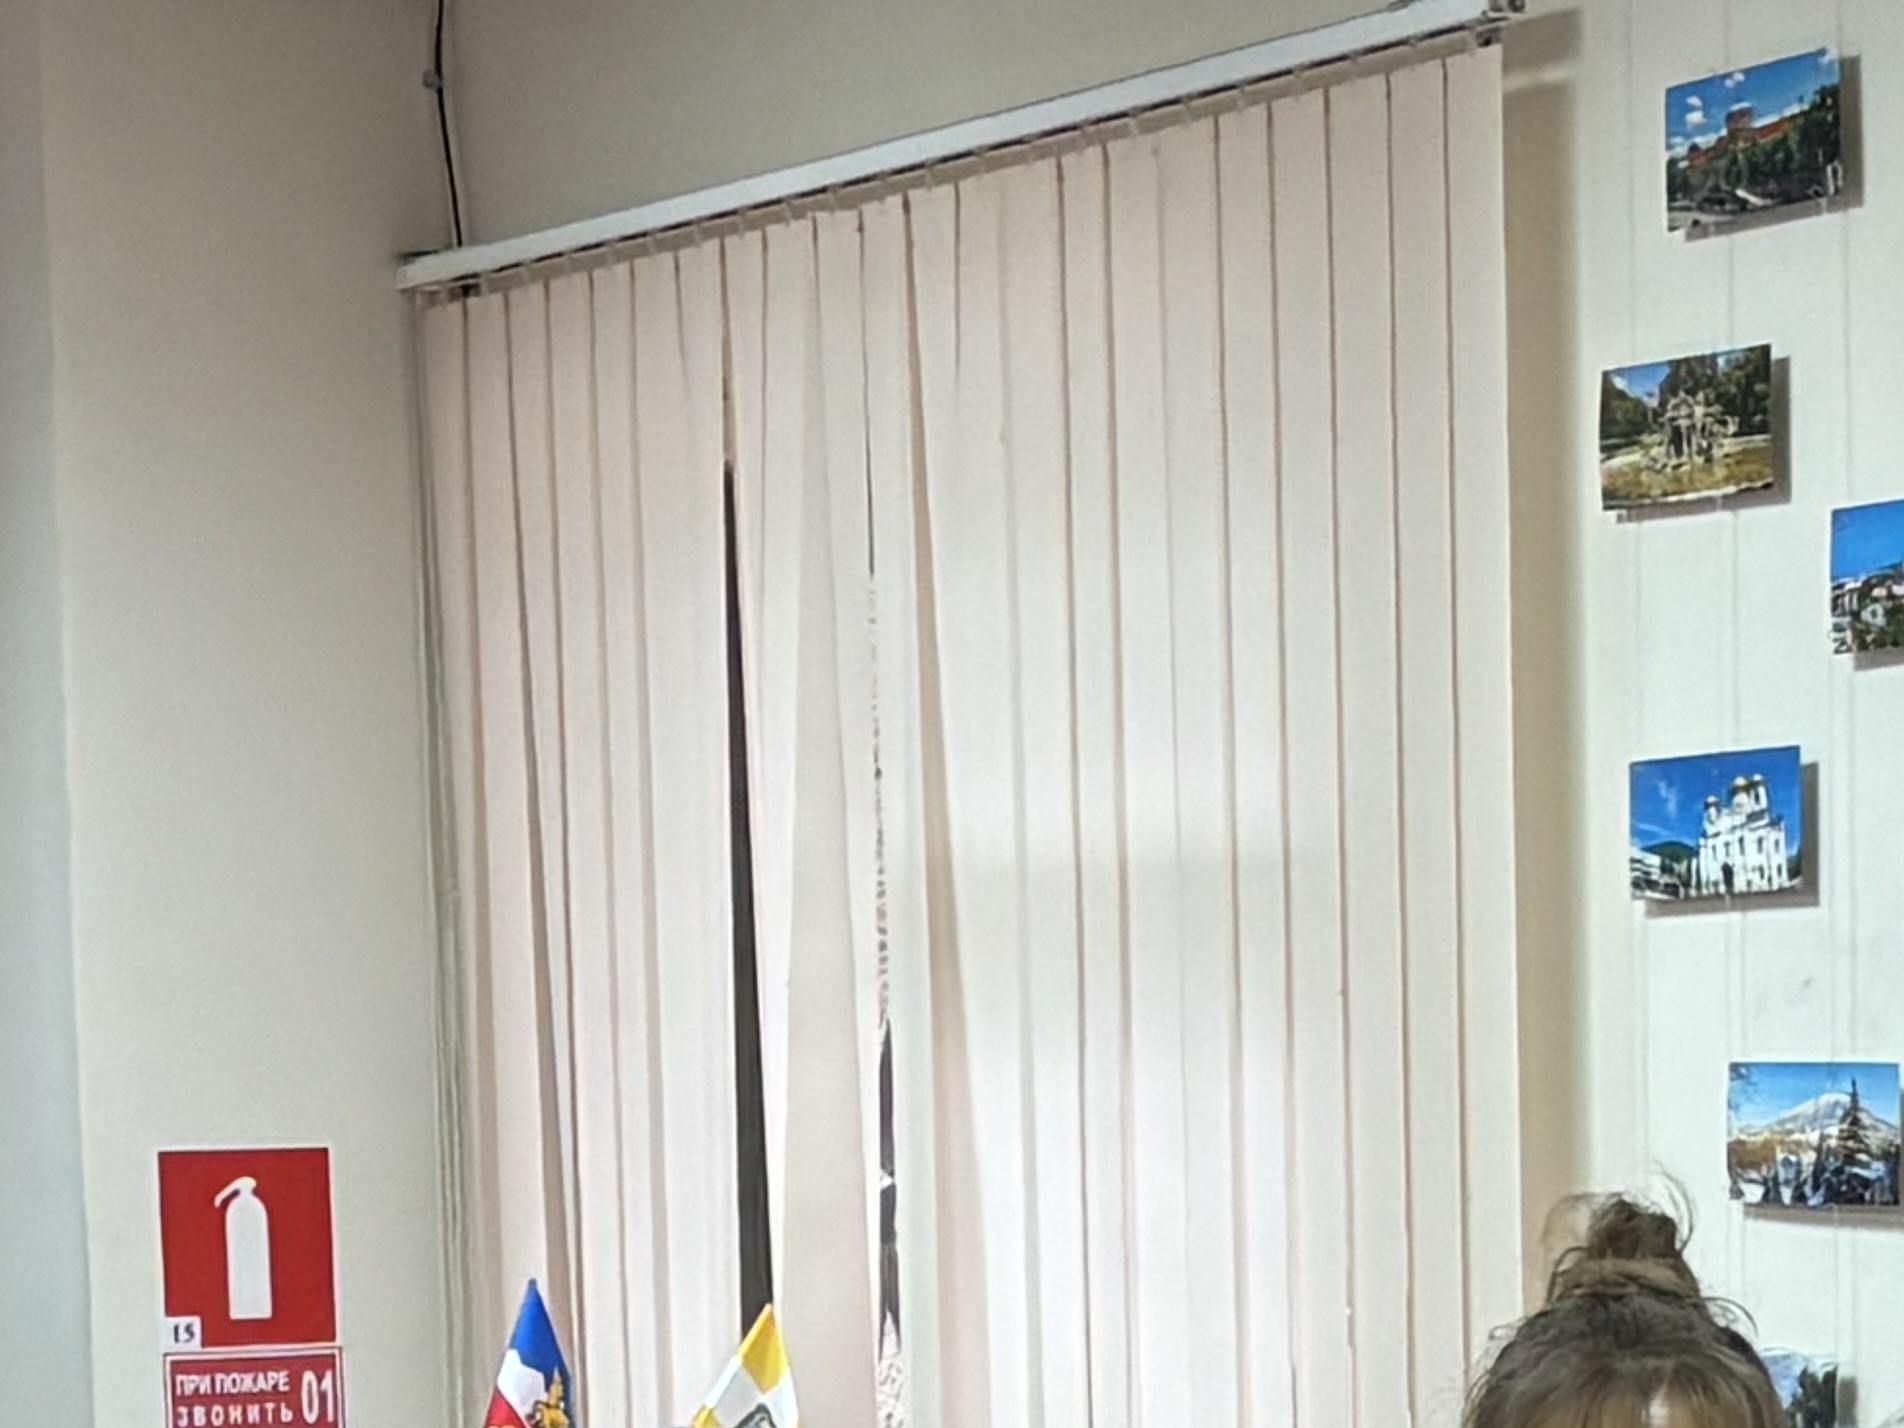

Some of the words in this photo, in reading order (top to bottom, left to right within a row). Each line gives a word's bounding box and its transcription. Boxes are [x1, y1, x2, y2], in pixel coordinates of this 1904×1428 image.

[175, 1374, 211, 1397] ПРИ
[214, 1370, 290, 1395] ПОЖАРЕ
[300, 1369, 335, 1425] 01
[176, 1402, 294, 1428] ЗВОНИТЬ
